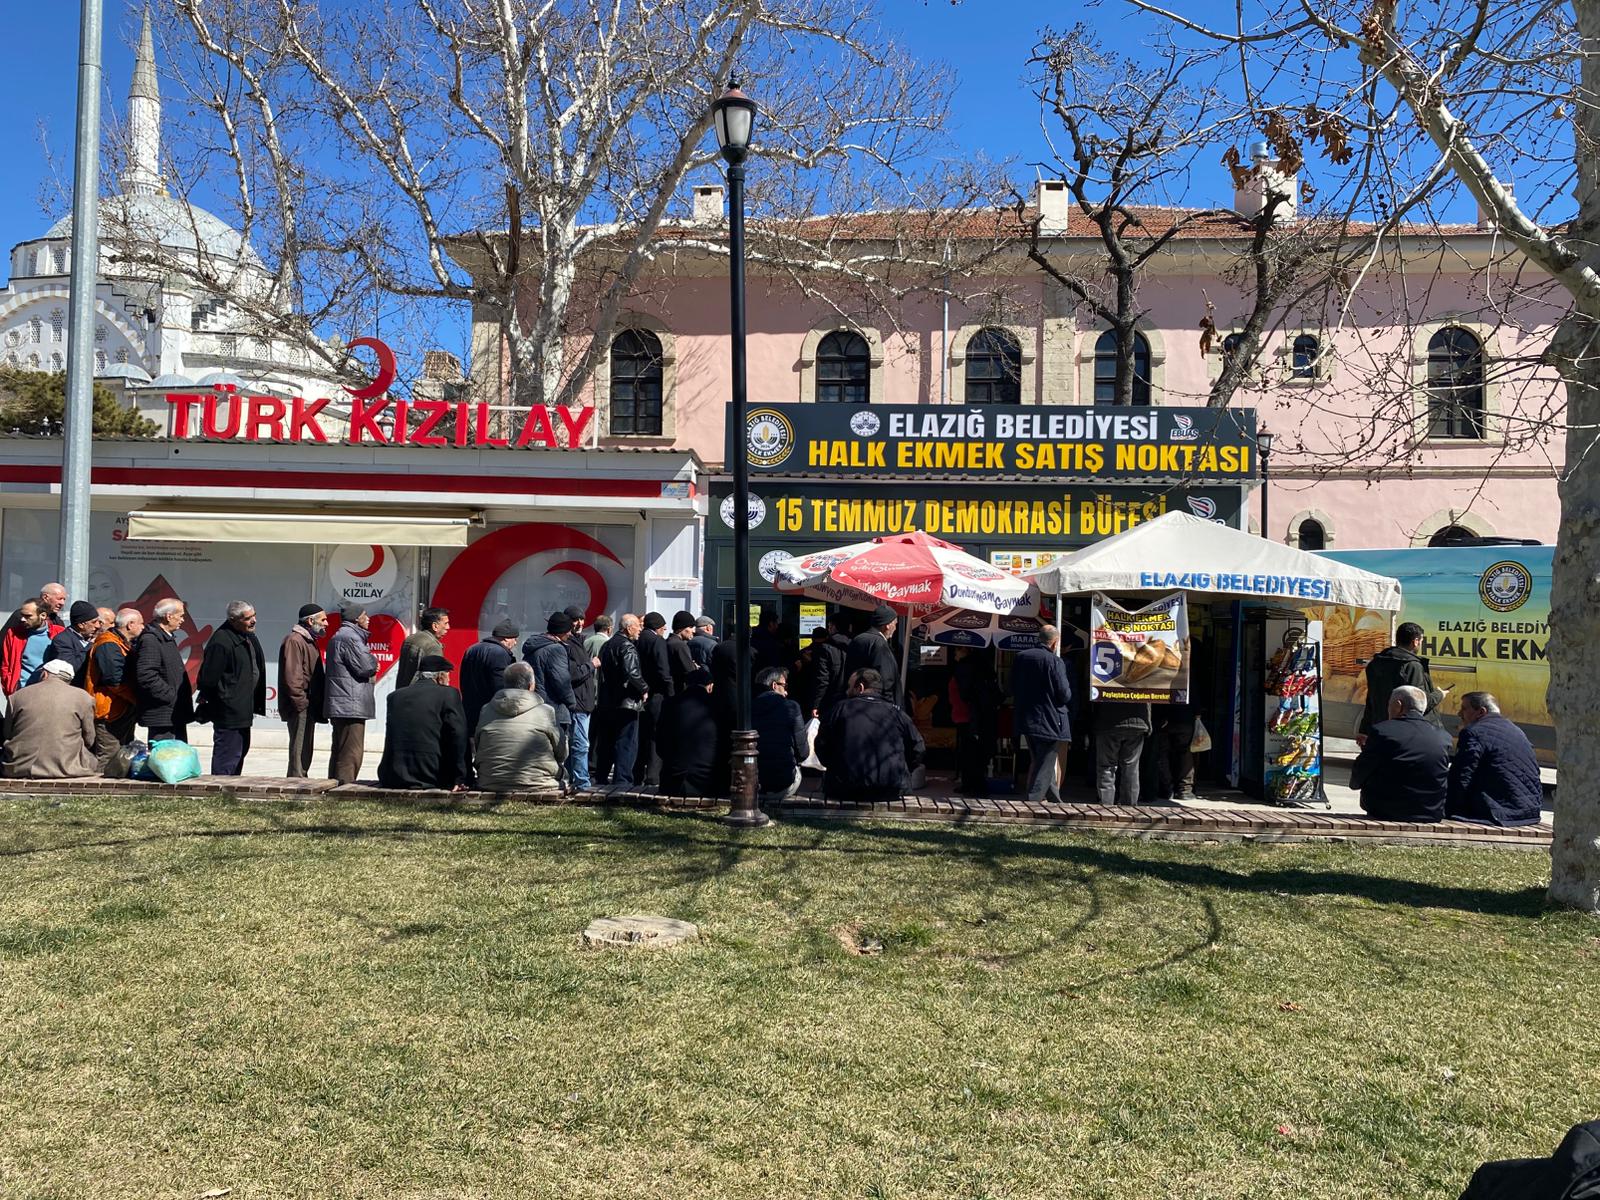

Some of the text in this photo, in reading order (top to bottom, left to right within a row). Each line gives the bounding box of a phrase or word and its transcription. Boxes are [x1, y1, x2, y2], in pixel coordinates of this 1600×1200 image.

[166, 383, 597, 449] TÜRK KIZILAY
[889, 408, 985, 438] ELAZIĞ
[995, 410, 1158, 441] BELEDİYESİ
[808, 440, 1249, 473] HALK EKMEK SATIŞ NOKTASI
[775, 497, 803, 532] 15
[811, 499, 917, 533] TEMMUZ
[924, 494, 1071, 535] DEMOKRASİ
[343, 588, 384, 598] KIZILAY
[888, 578, 932, 599] Gaymak
[1216, 573, 1332, 599] BELEDİYESİ
[994, 592, 1032, 610] Gaymak
[1149, 595, 1184, 611] EDİYESİ
[1106, 610, 1172, 622] HALK EKMEK
[1133, 621, 1175, 632] NOKTASI
[1438, 619, 1551, 635] ELAZIĞ BELEDİY
[366, 642, 389, 653] ANIN;
[1422, 637, 1549, 661] HALK EKM
[1093, 648, 1116, 676] 5
